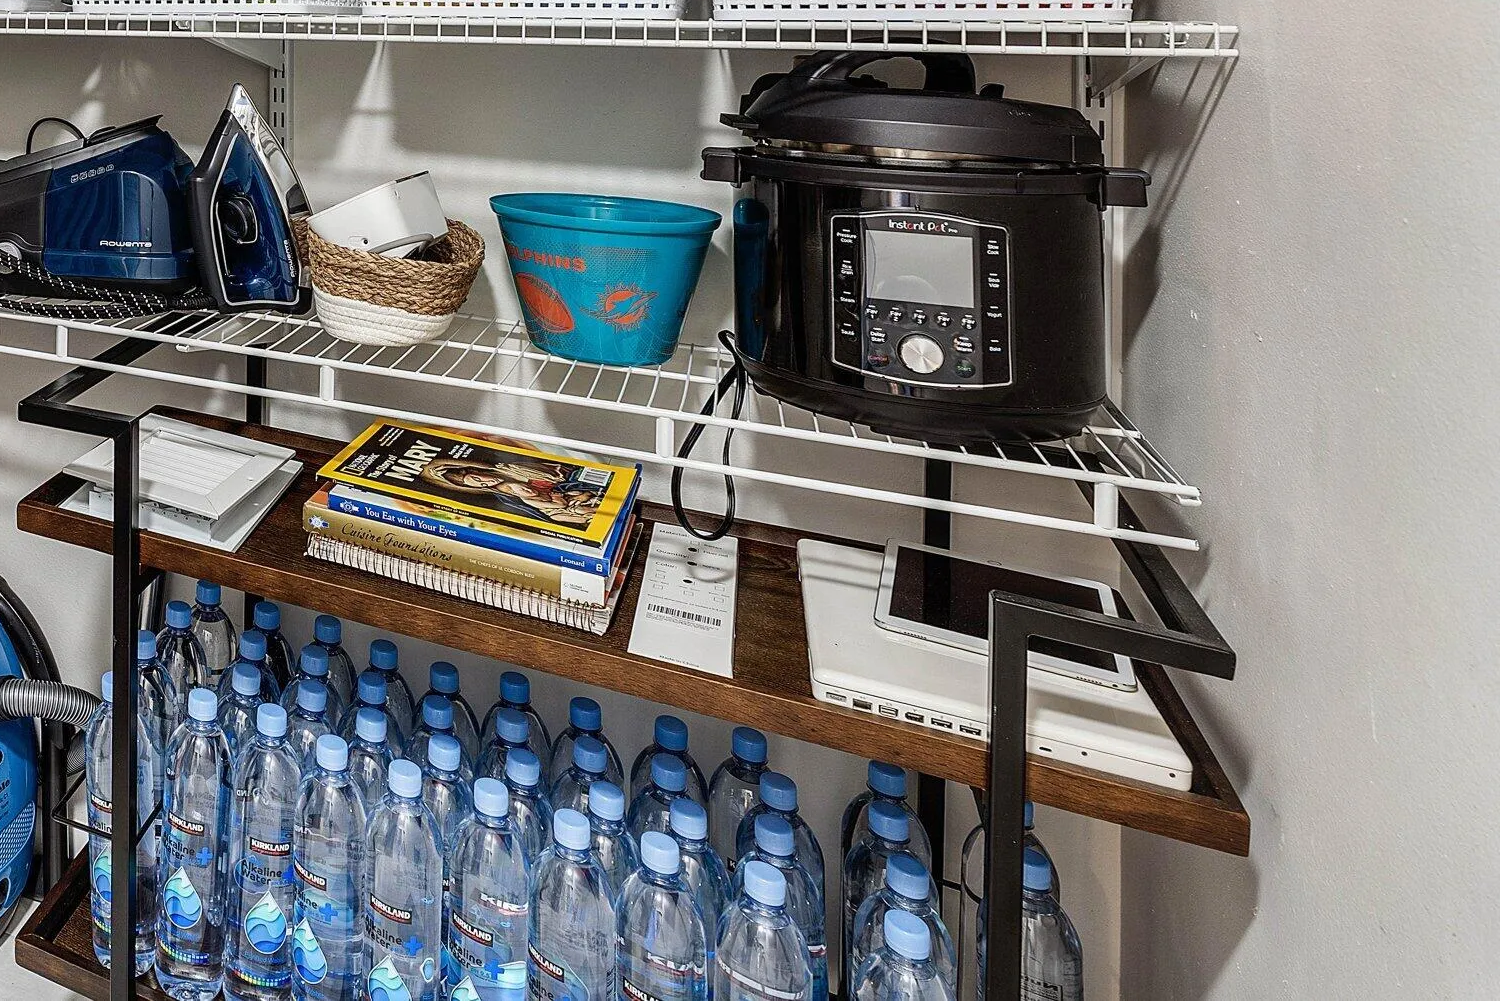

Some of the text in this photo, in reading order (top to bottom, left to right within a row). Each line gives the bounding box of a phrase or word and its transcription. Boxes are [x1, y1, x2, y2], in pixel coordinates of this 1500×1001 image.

[889, 219, 925, 231] Instant
[928, 221, 946, 233] Pot
[100, 240, 152, 248] Rowenta
[836, 232, 858, 240] Pressure
[283, 239, 296, 278] Rowenta
[937, 315, 950, 323] Fav
[961, 318, 975, 326] Fav
[368, 467, 382, 479] The
[377, 458, 393, 473] Story
[385, 439, 442, 482] MARY
[364, 507, 457, 537] You Eat with Your Eyes
[342, 522, 453, 562] Cuisine Foundations
[540, 529, 584, 543] SPECIAL PUBLICATION
[478, 560, 492, 569] CHEFS
[503, 567, 524, 576] CORDON
[560, 556, 585, 568] Leonard
[655, 561, 678, 569] Color:
[169, 814, 204, 832] KIRKLAND
[251, 839, 290, 852] KIRKLAND
[241, 859, 282, 878] Alkaline
[242, 869, 272, 885] Water
[371, 896, 411, 920] KIRKLAND
[453, 914, 492, 942] KIRKLAND
